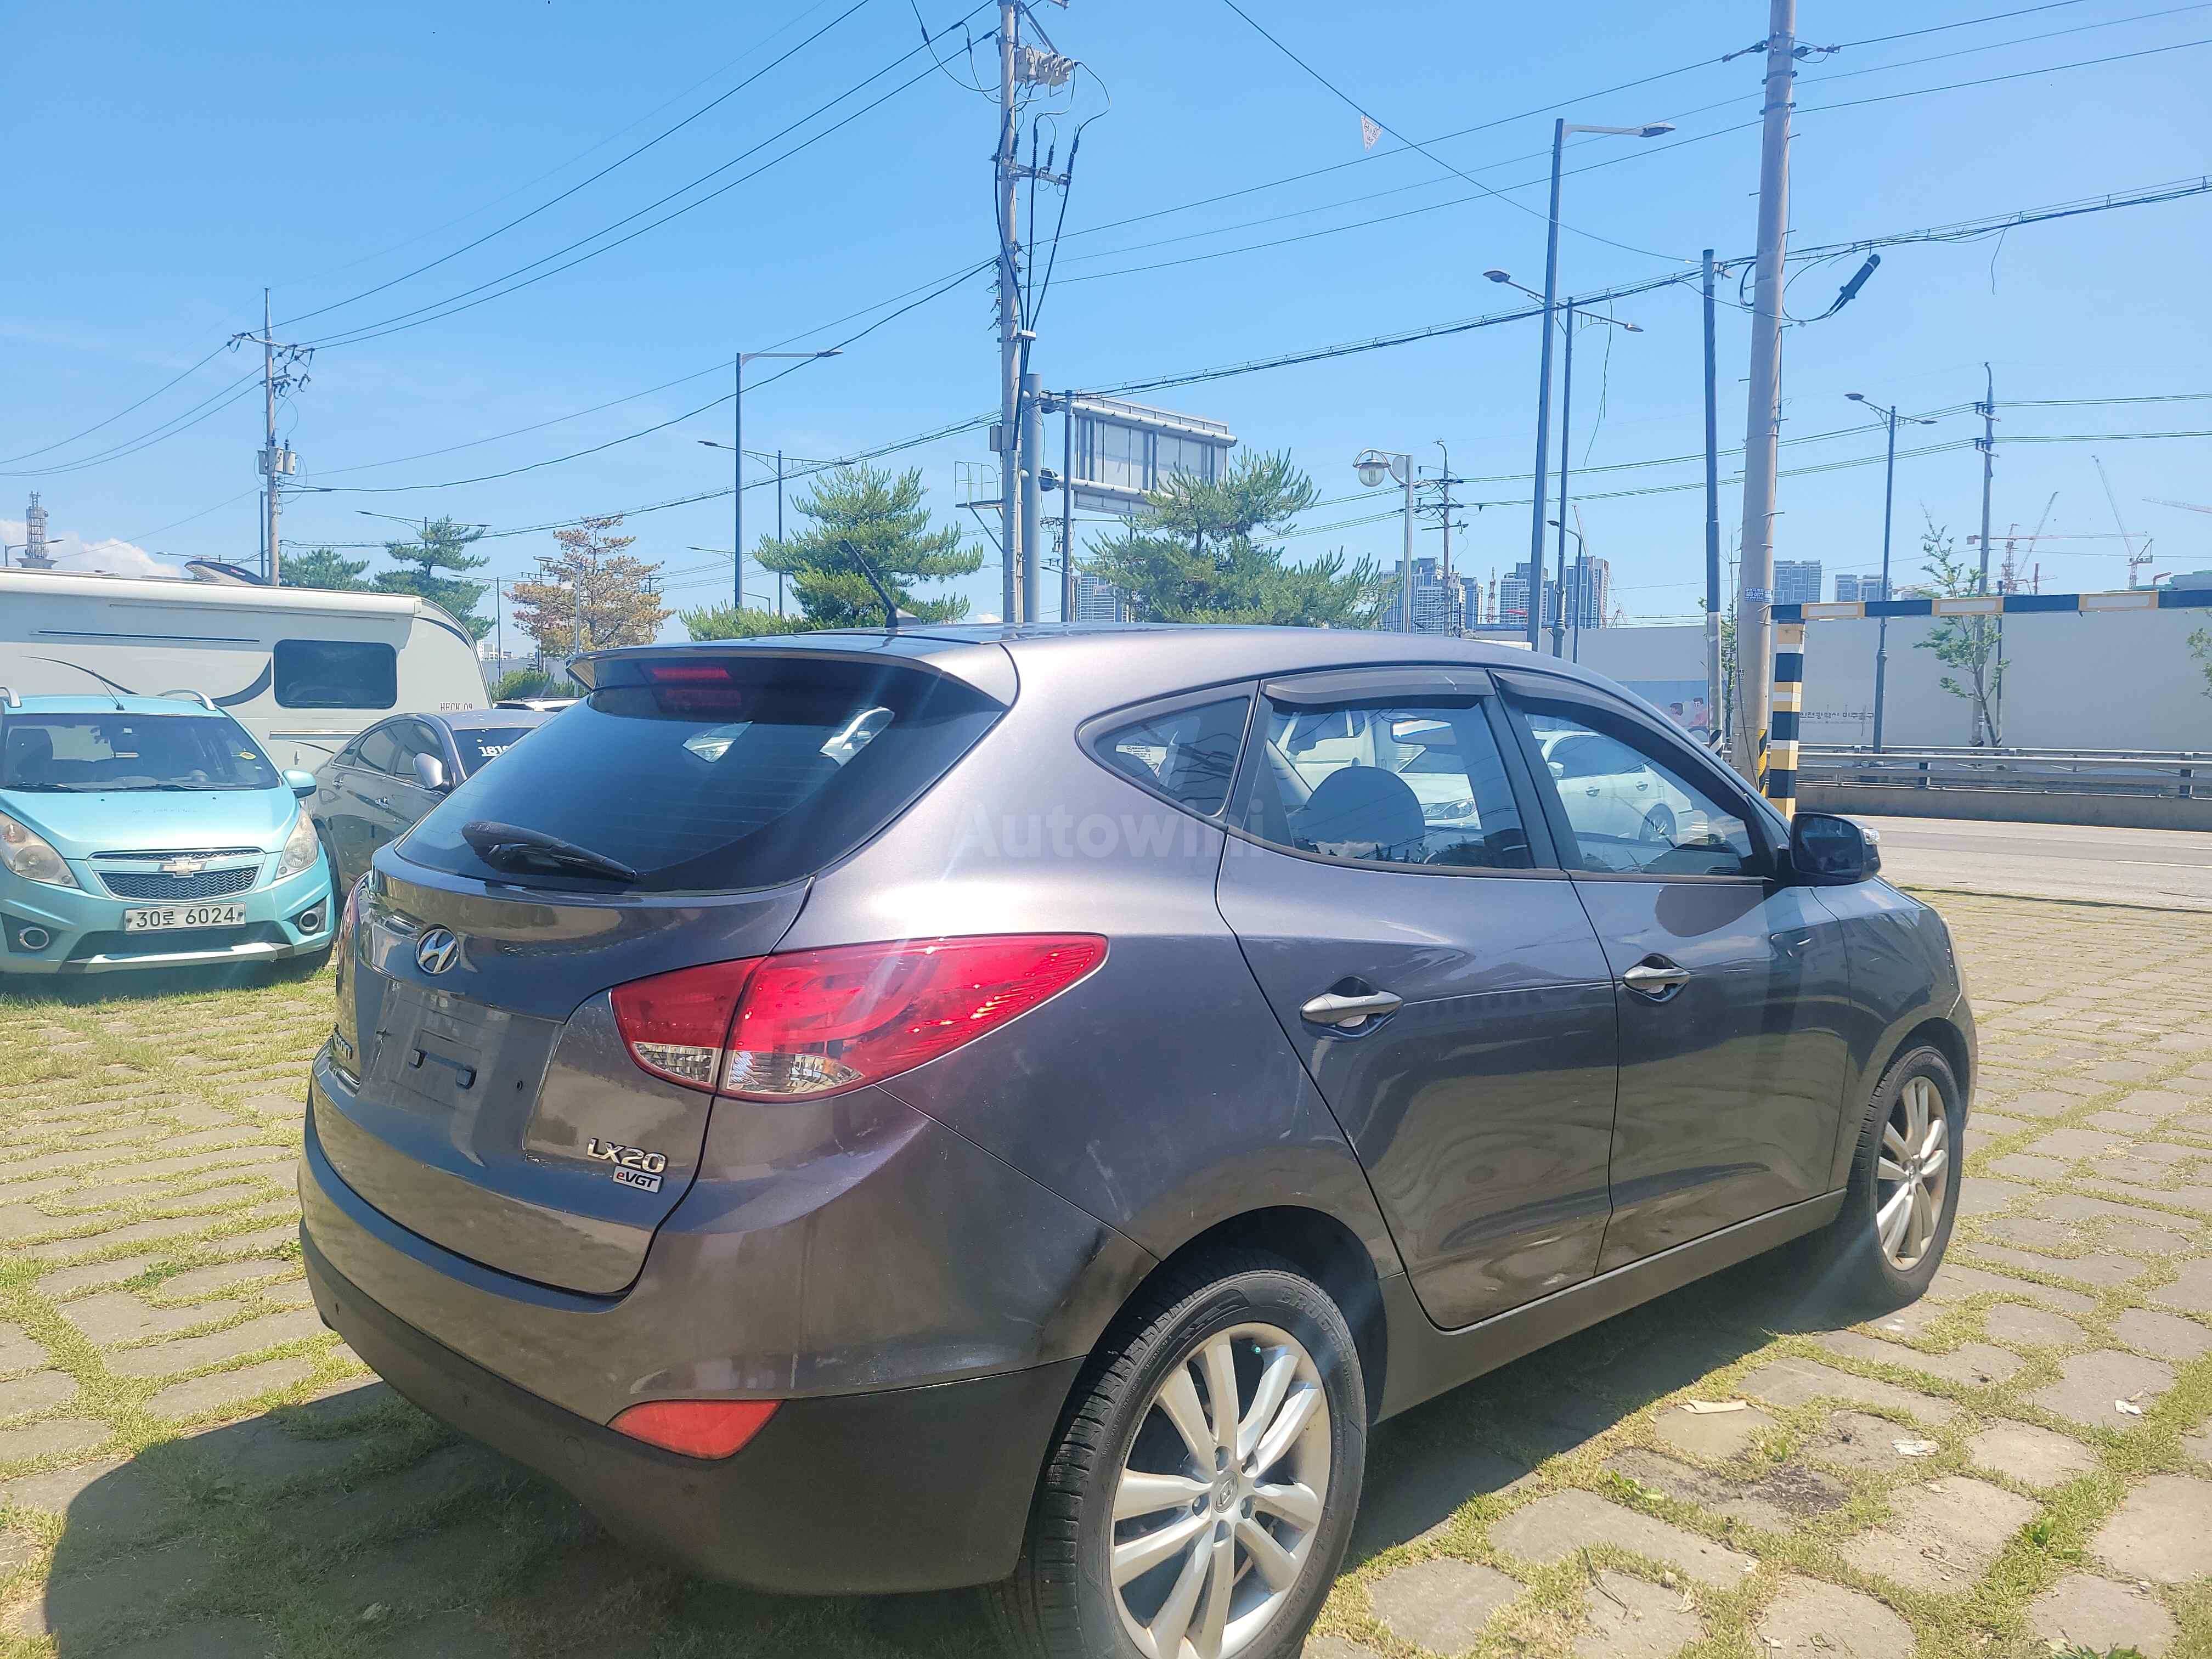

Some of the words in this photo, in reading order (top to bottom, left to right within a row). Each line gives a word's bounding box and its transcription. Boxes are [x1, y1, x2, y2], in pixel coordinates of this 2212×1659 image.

[137, 910, 175, 927] 30로
[185, 907, 235, 924] 6024
[587, 1137, 667, 1173] LX20
[617, 1171, 658, 1188] eVGT
